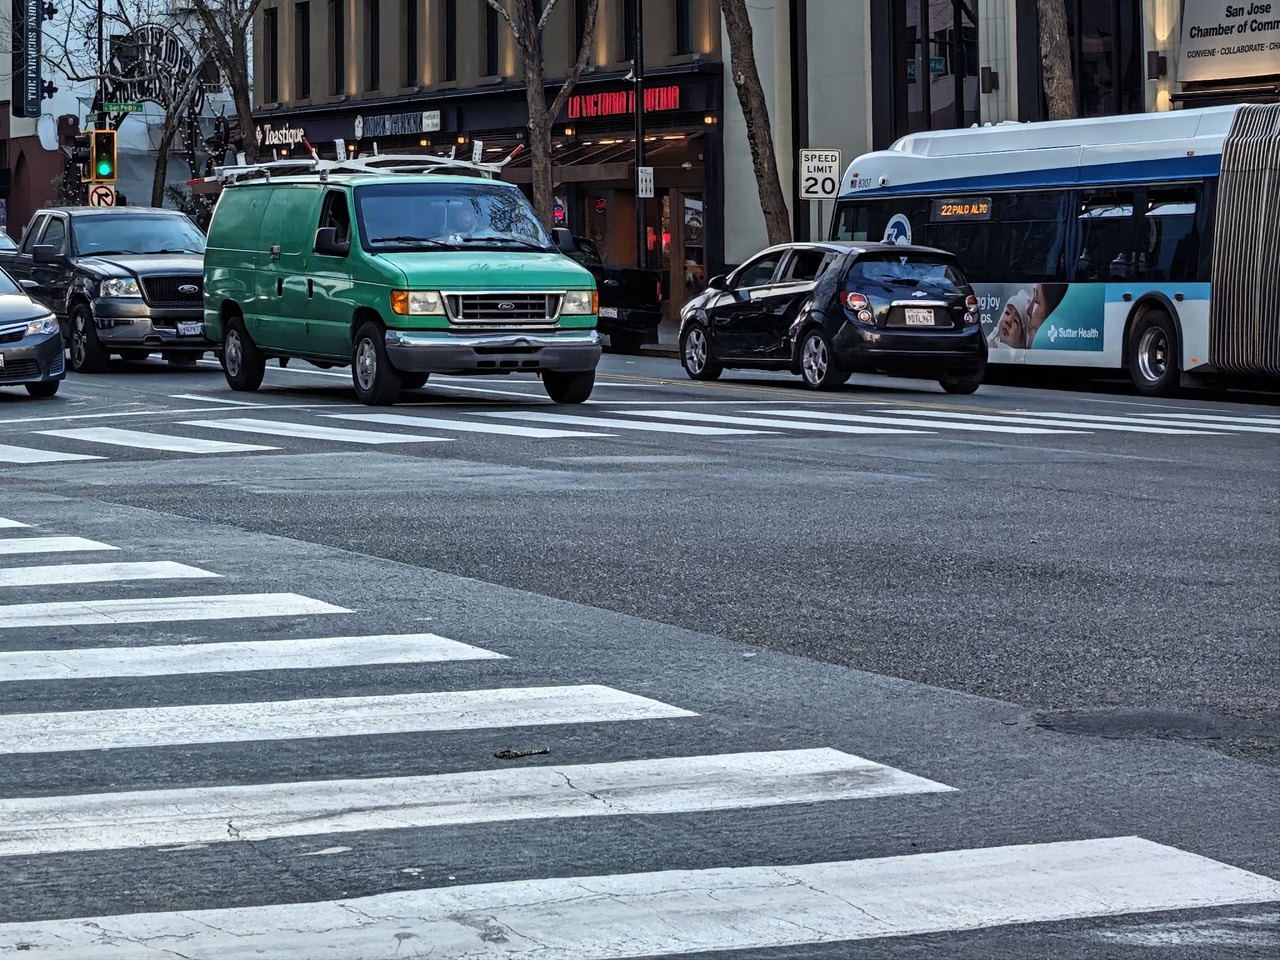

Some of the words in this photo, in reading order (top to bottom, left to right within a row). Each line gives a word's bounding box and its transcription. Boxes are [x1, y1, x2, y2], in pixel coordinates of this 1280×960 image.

[1225, 5, 1244, 18] San
[1247, 2, 1272, 16] Jose
[1189, 23, 1236, 39] Chamber
[1237, 20, 1248, 34] of
[27, 31, 37, 78] FARMERS
[1187, 48, 1216, 59] CONVENE
[1220, 43, 1265, 56] COLLABORATE
[27, 80, 37, 100] THE
[264, 123, 304, 150] Toastique
[804, 154, 837, 163] SPEED
[807, 166, 833, 174] LIMIT
[804, 177, 836, 194] 20
[858, 178, 872, 188] 8307
[987, 293, 1001, 310] joy
[1058, 327, 1078, 337] Sutter
[1078, 327, 1099, 338] Health
